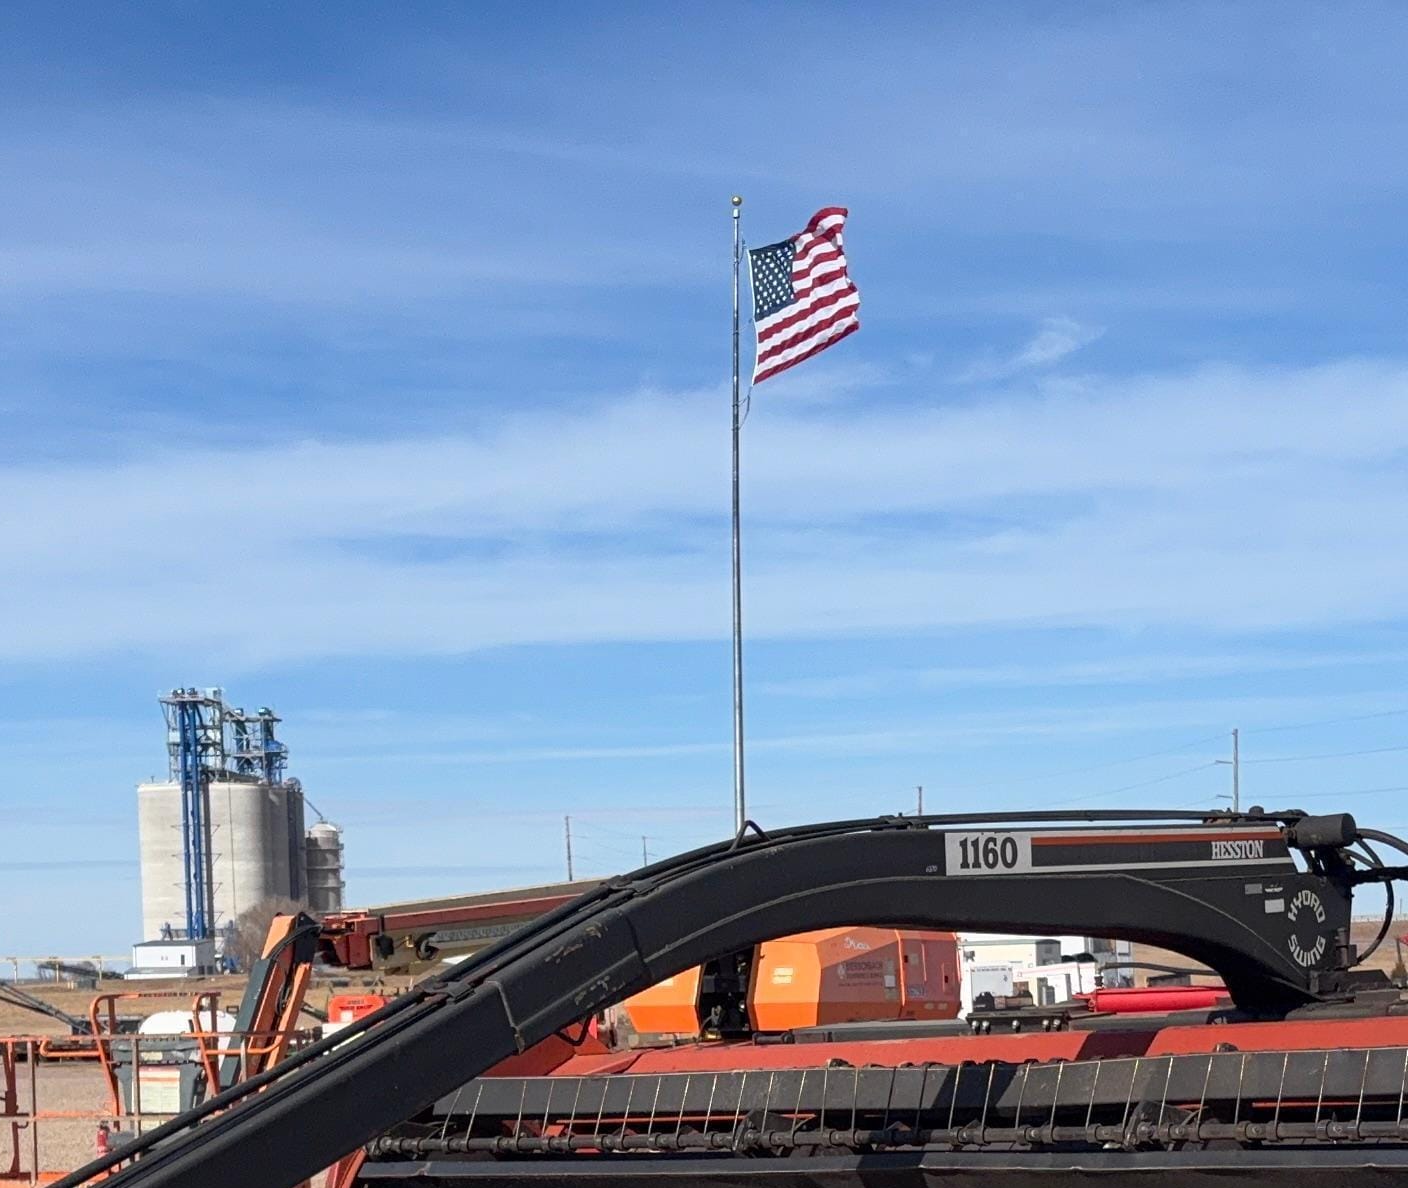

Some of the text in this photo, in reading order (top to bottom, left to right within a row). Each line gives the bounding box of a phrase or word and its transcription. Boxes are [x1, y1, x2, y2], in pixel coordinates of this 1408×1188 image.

[959, 836, 1018, 869] 1160
[1211, 840, 1264, 860] HESSTON
[1287, 889, 1326, 923] HYDRO
